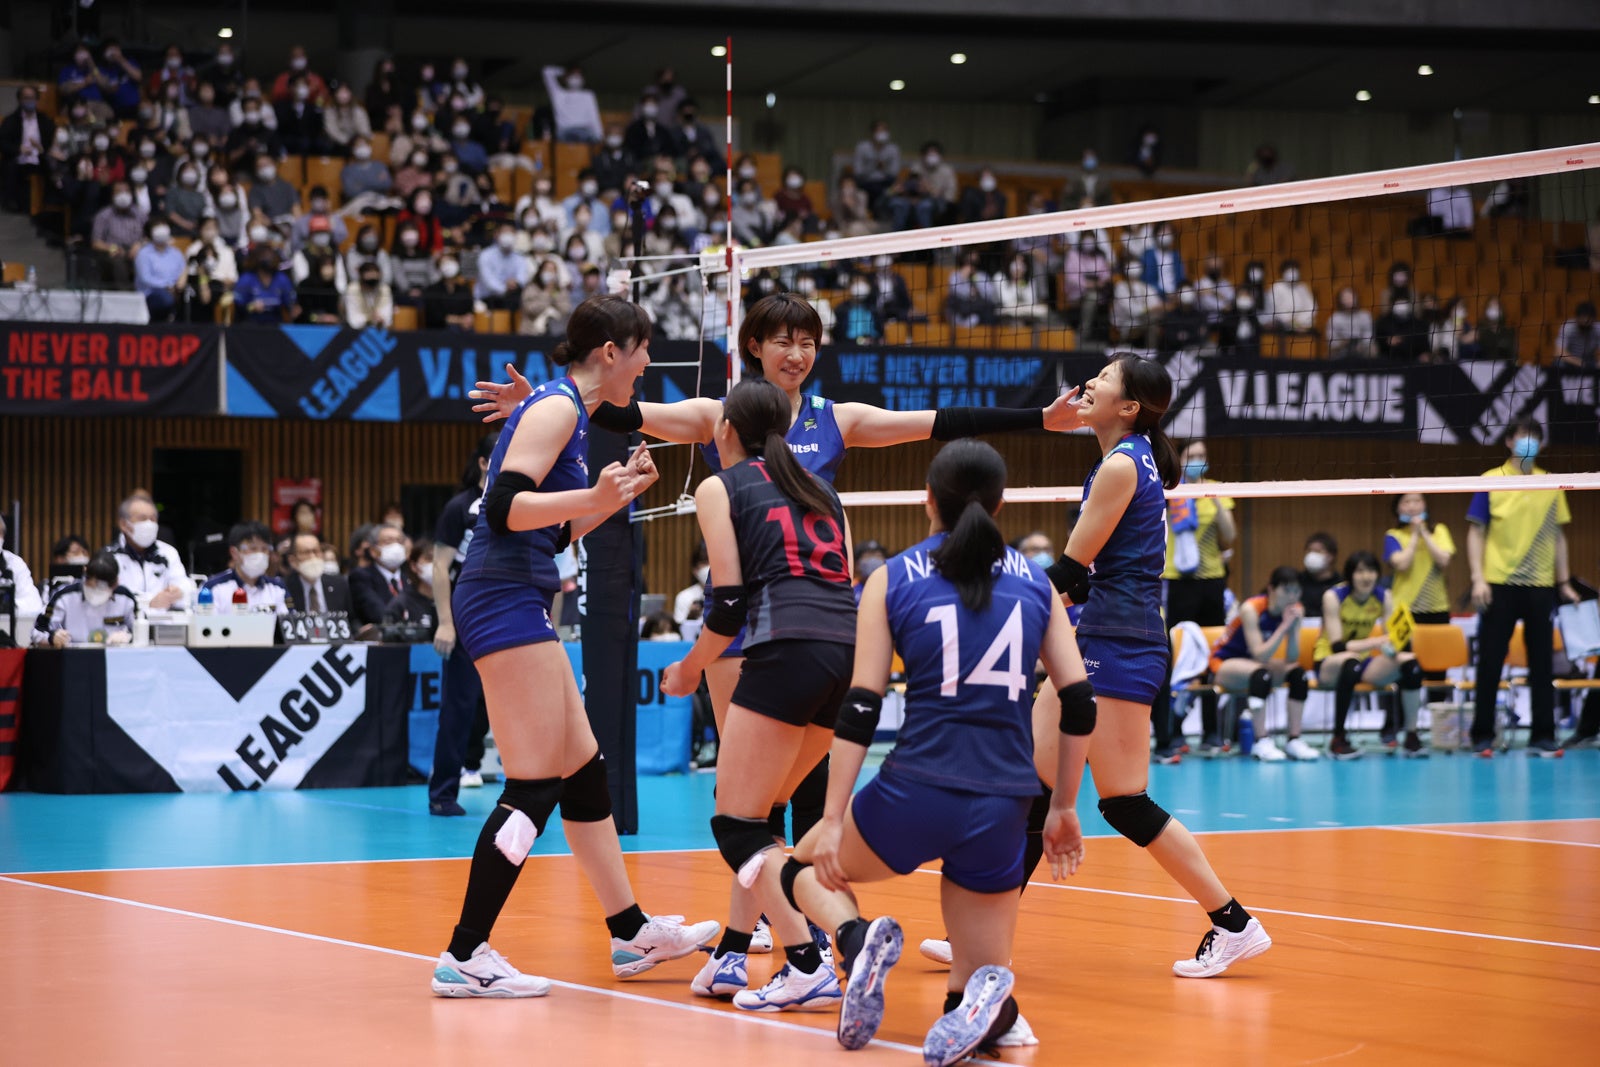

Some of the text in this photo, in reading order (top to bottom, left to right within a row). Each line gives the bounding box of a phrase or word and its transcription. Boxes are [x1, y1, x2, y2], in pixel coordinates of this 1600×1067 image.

[8, 331, 200, 367] NEVER DROP
[299, 325, 398, 419] LEAGUE
[838, 353, 879, 384] WE
[884, 354, 967, 386] NEVER
[3, 368, 149, 401] THE BALL
[1217, 370, 1405, 422] V.LEAGUE
[766, 506, 851, 582] 18
[283, 619, 308, 640] 24
[327, 619, 351, 639] 23
[924, 600, 1026, 702] 14
[217, 645, 367, 792] LEAGUE
